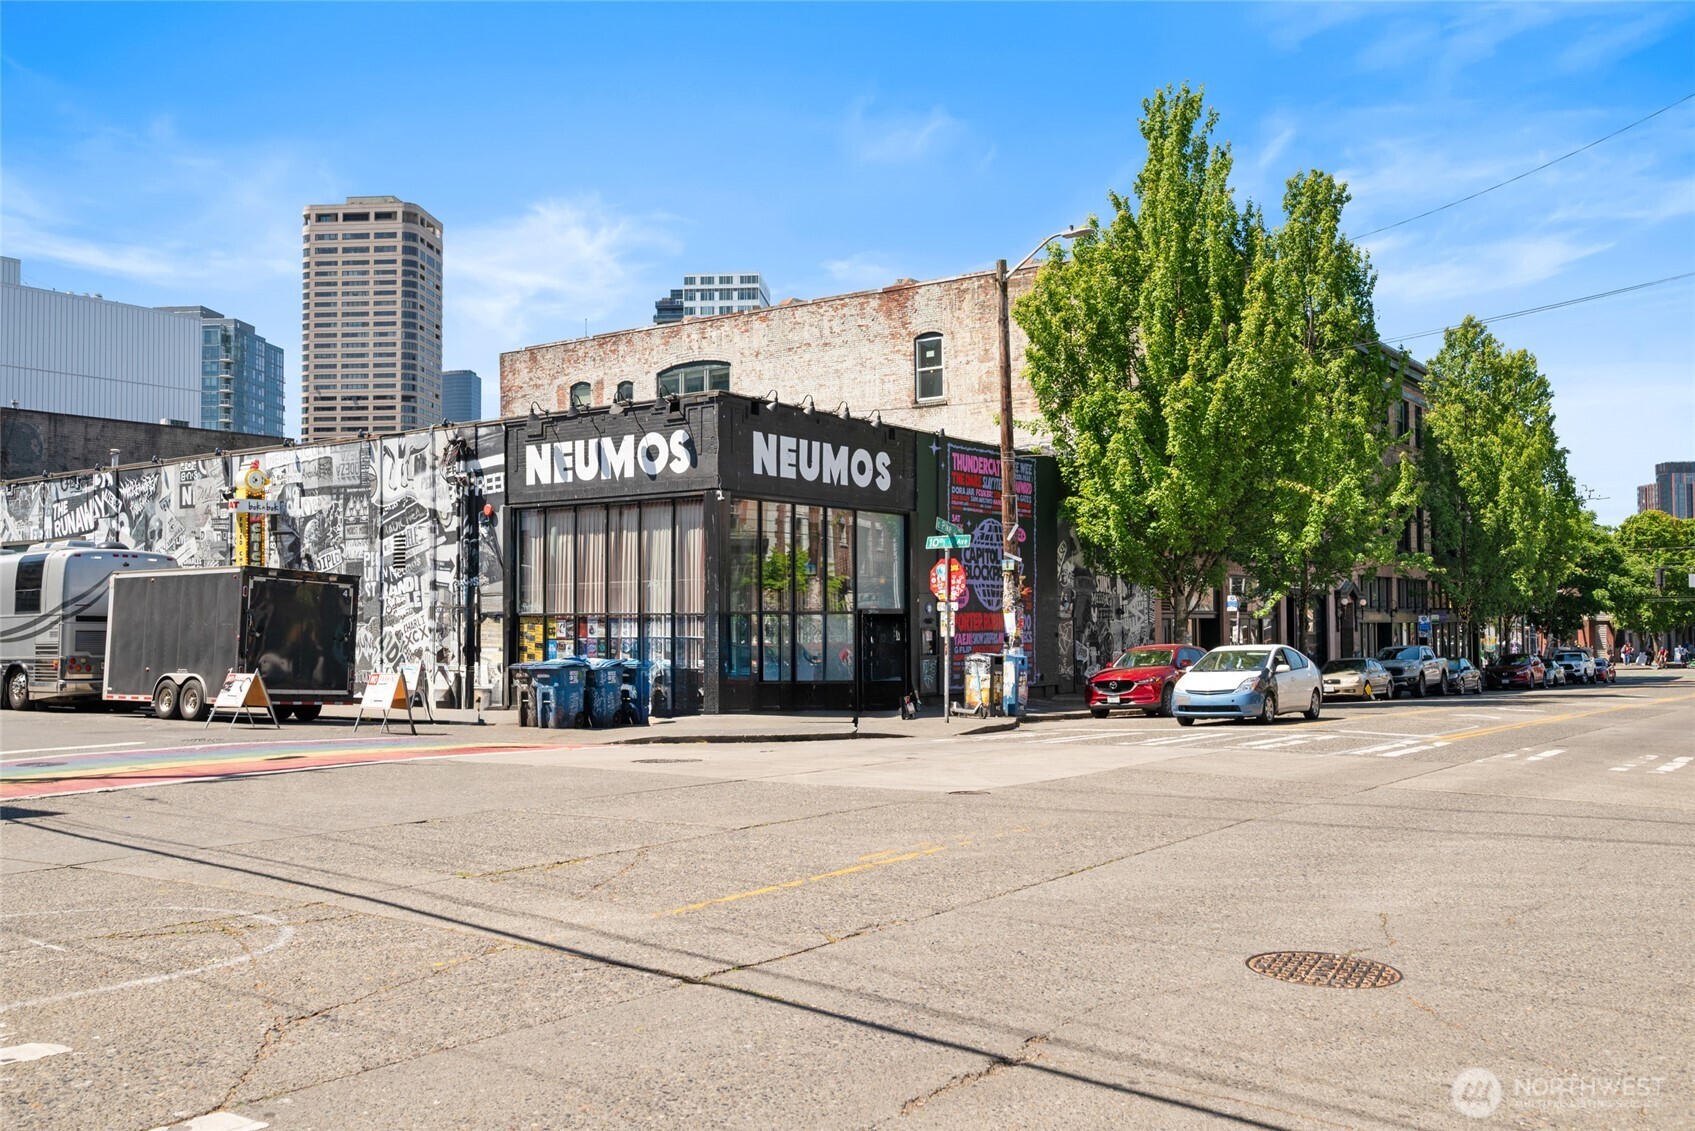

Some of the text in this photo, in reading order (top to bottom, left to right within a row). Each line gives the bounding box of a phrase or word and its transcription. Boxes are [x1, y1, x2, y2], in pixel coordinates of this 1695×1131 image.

[526, 429, 691, 486] NEUMOS
[752, 431, 892, 492] NEUMOS
[952, 452, 1001, 476] THUNDERCAT
[53, 500, 69, 521] THE
[54, 490, 109, 537] RUNAWAY
[248, 502, 262, 511] bok
[266, 503, 279, 512] bok
[963, 547, 1001, 564] CAPITOL
[964, 565, 1003, 580] BLOCKPA
